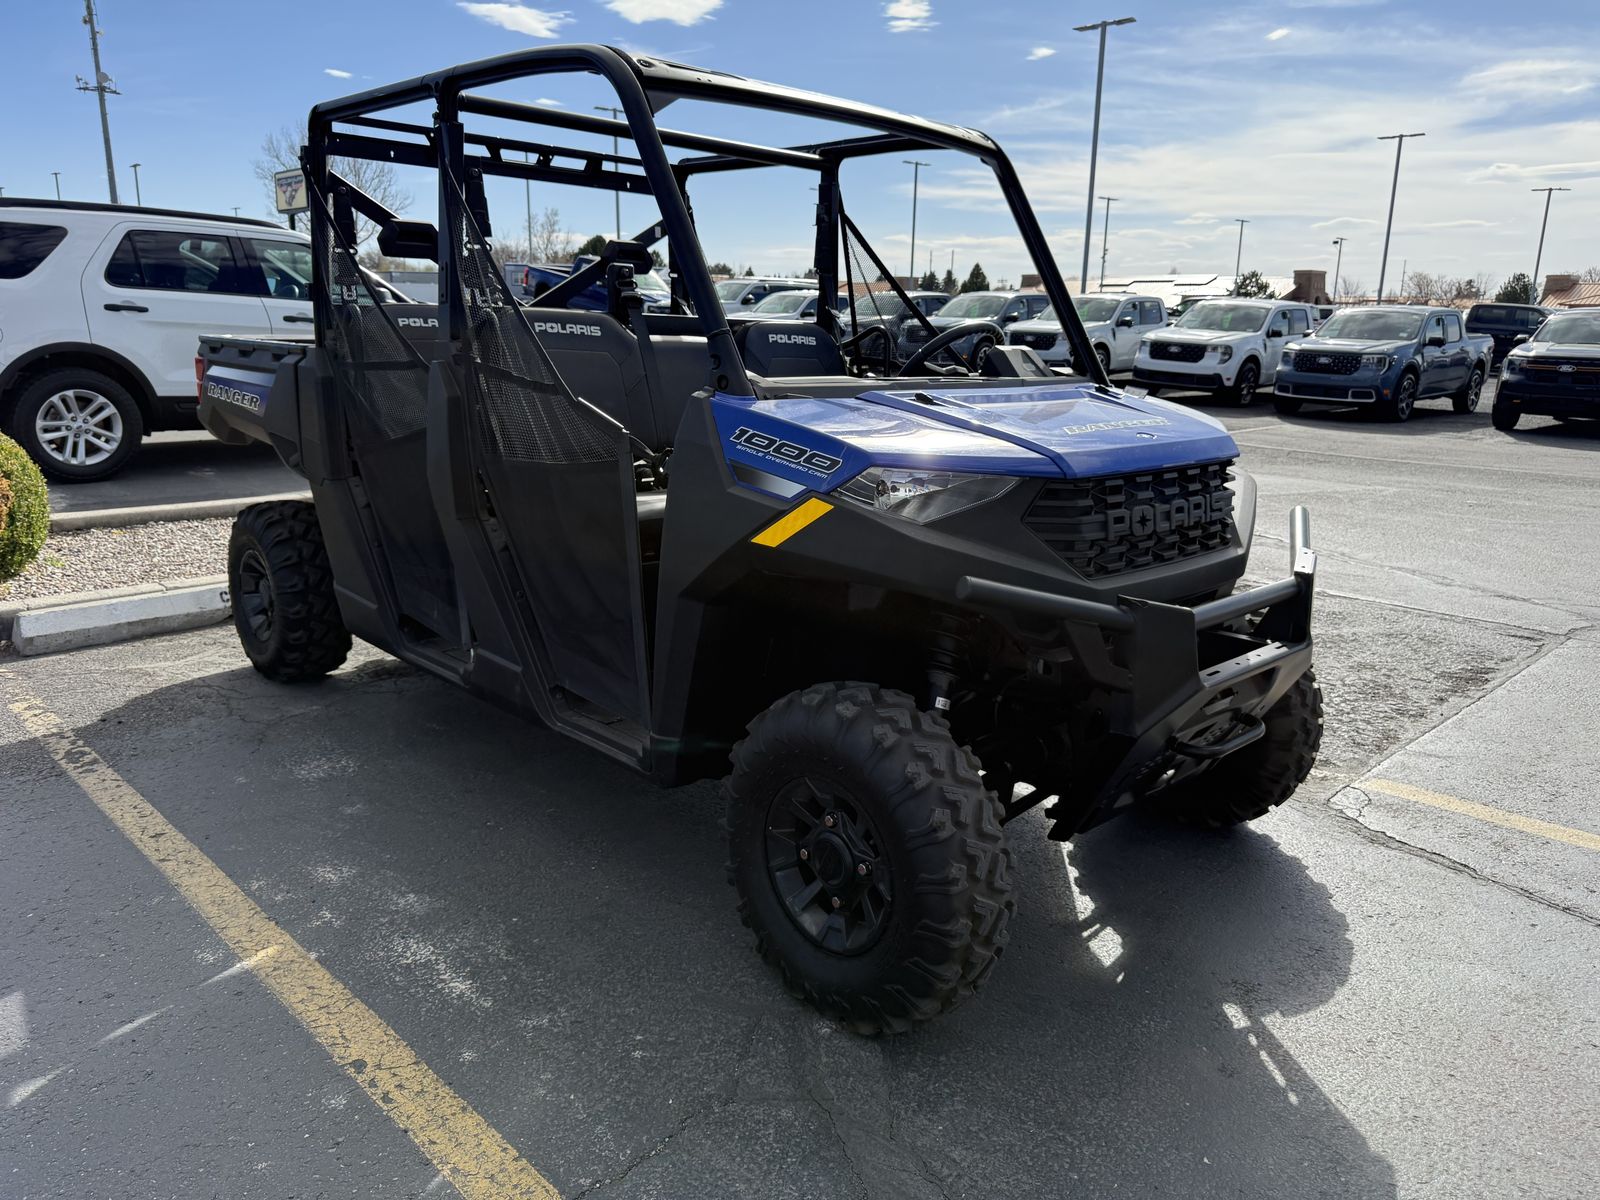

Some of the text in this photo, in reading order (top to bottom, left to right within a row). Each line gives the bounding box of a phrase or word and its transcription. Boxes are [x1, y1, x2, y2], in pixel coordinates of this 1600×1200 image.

[533, 321, 602, 337] POLARIS
[768, 333, 817, 346] POLARIS
[207, 381, 261, 411] RANGER
[729, 426, 843, 474] 1000
[735, 444, 829, 480] SINGLE OVERHEAD CAM
[1106, 489, 1236, 541] POLARIS
